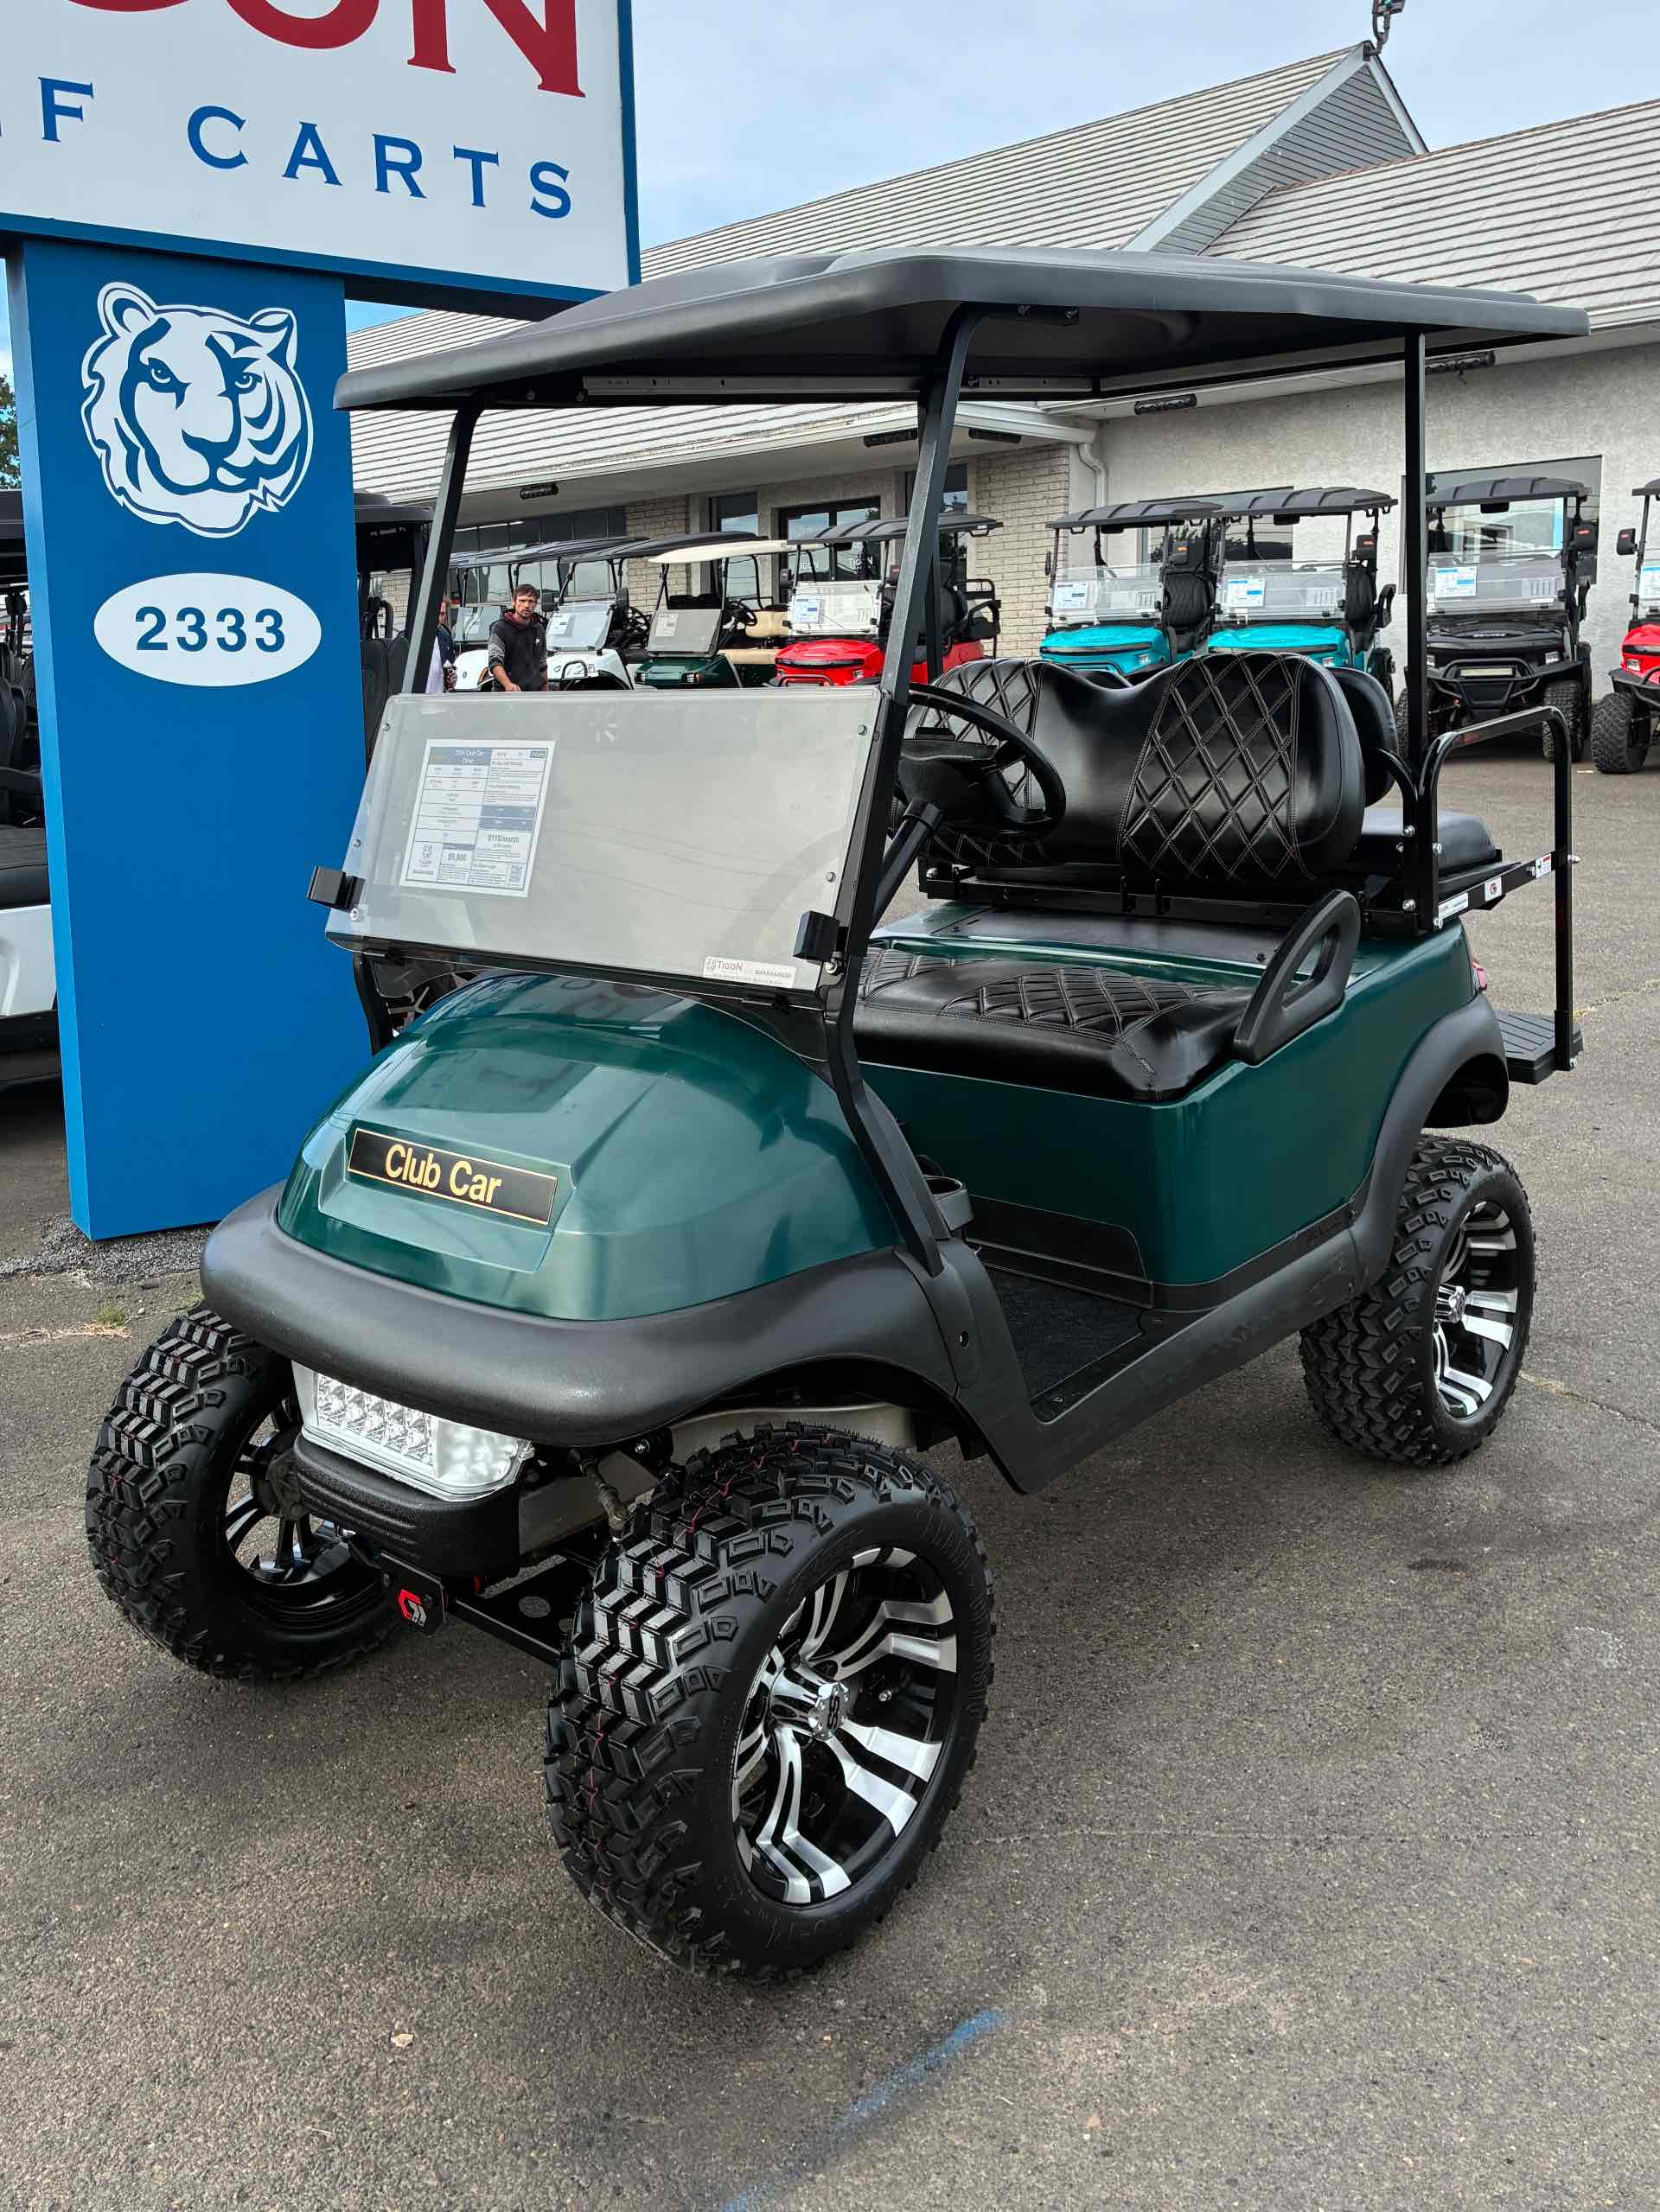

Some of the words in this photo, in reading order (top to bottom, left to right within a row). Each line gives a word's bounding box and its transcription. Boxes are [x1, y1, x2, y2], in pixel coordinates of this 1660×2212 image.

[0, 76, 93, 143] F
[186, 105, 572, 220] CARTS
[134, 605, 286, 653] 2333
[385, 1144, 442, 1189] Club
[449, 1160, 502, 1204] Car
